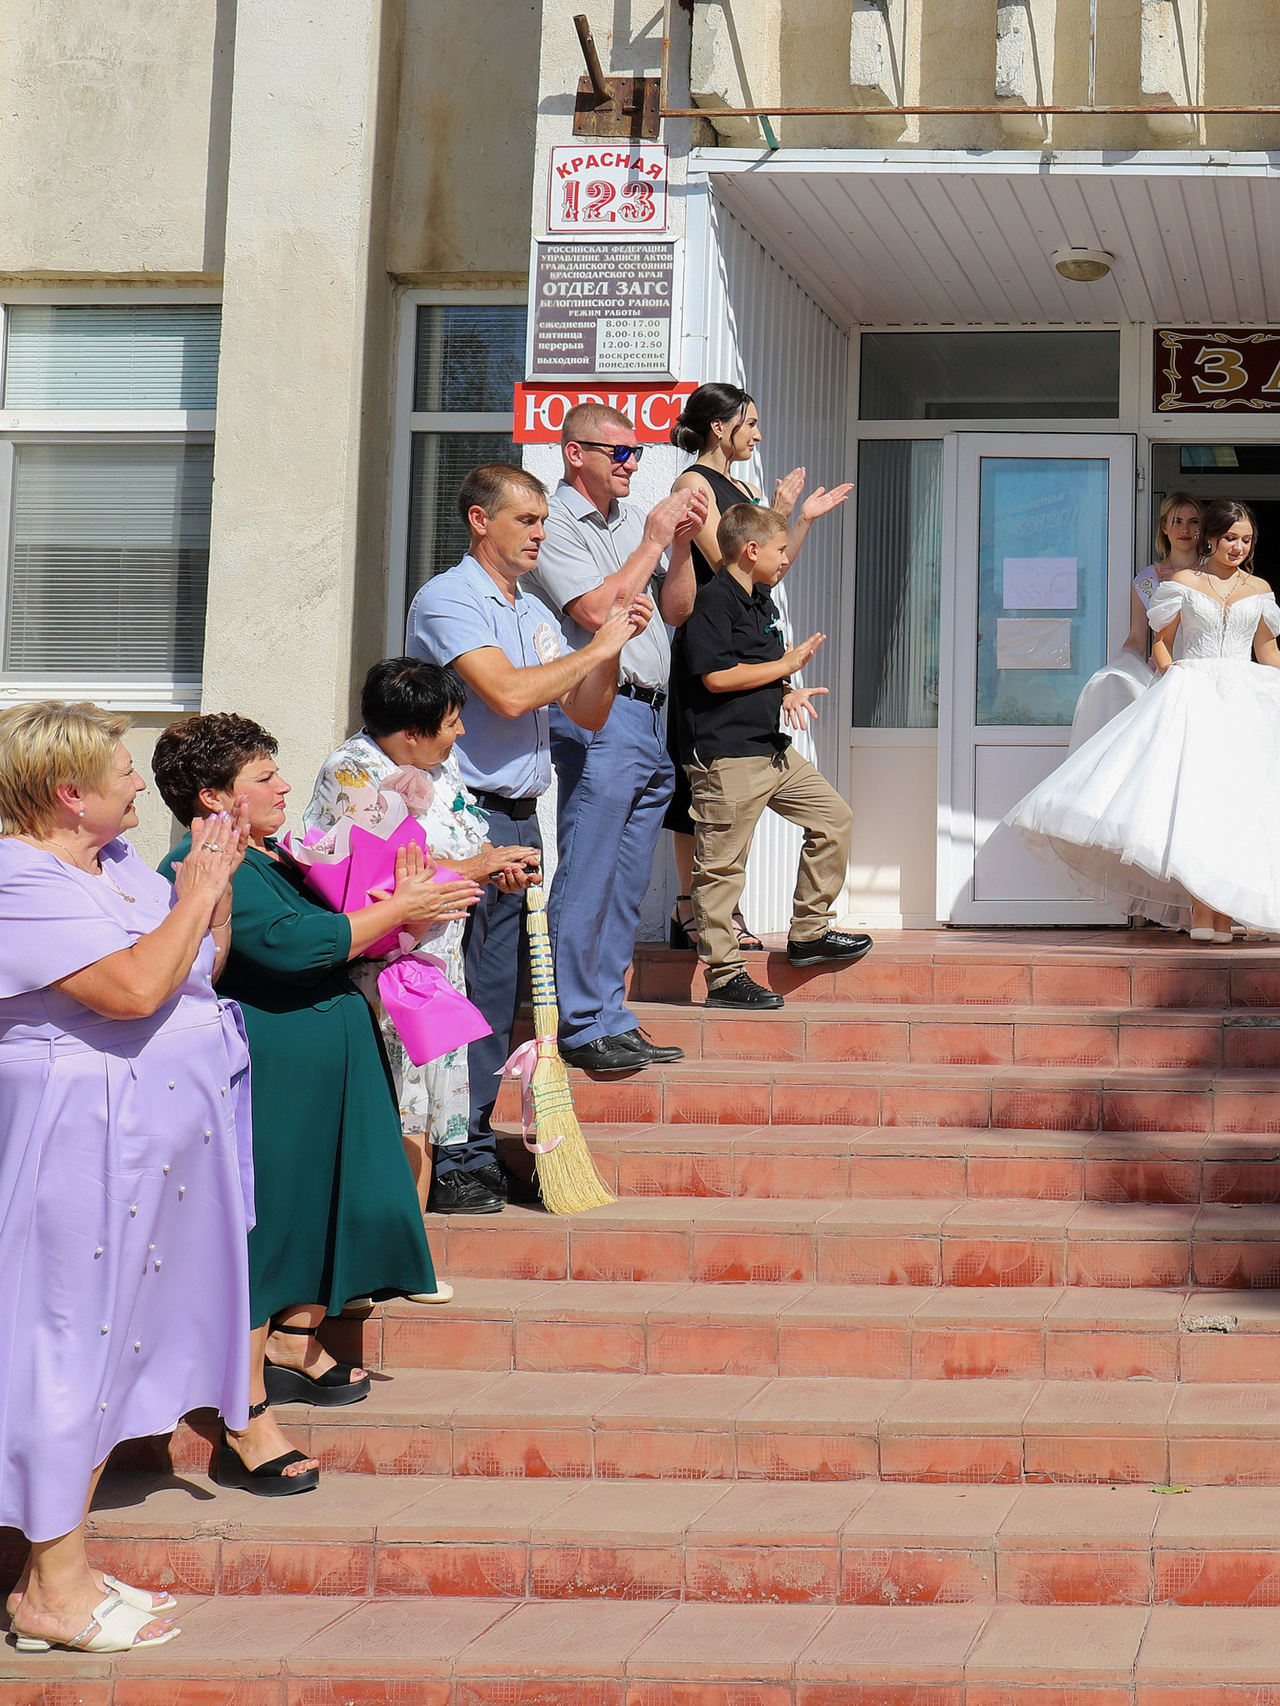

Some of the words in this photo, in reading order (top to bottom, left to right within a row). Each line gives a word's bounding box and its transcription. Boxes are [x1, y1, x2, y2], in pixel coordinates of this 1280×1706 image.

[556, 152, 663, 179] КРАСНАЯ
[561, 180, 655, 223] 123
[612, 245, 667, 253] ФЕДЕРАЦИЯ
[541, 254, 600, 262] УПРАВЛЕНИЕ
[604, 254, 640, 262] ЗАПИСИ
[540, 262, 615, 270] ГРАЖДАНСКОГО
[618, 262, 673, 270] СОСТОЯНИЯ
[550, 271, 634, 279] КРАСНОДАРСКОГО
[542, 282, 608, 298] ОТДЕЛ
[616, 282, 668, 296] ЗАГС
[629, 298, 670, 307] РАЙОНА
[540, 321, 596, 329] ежедневно
[539, 332, 583, 340] пятница
[538, 342, 584, 351] перерыв
[537, 356, 589, 366] выходной
